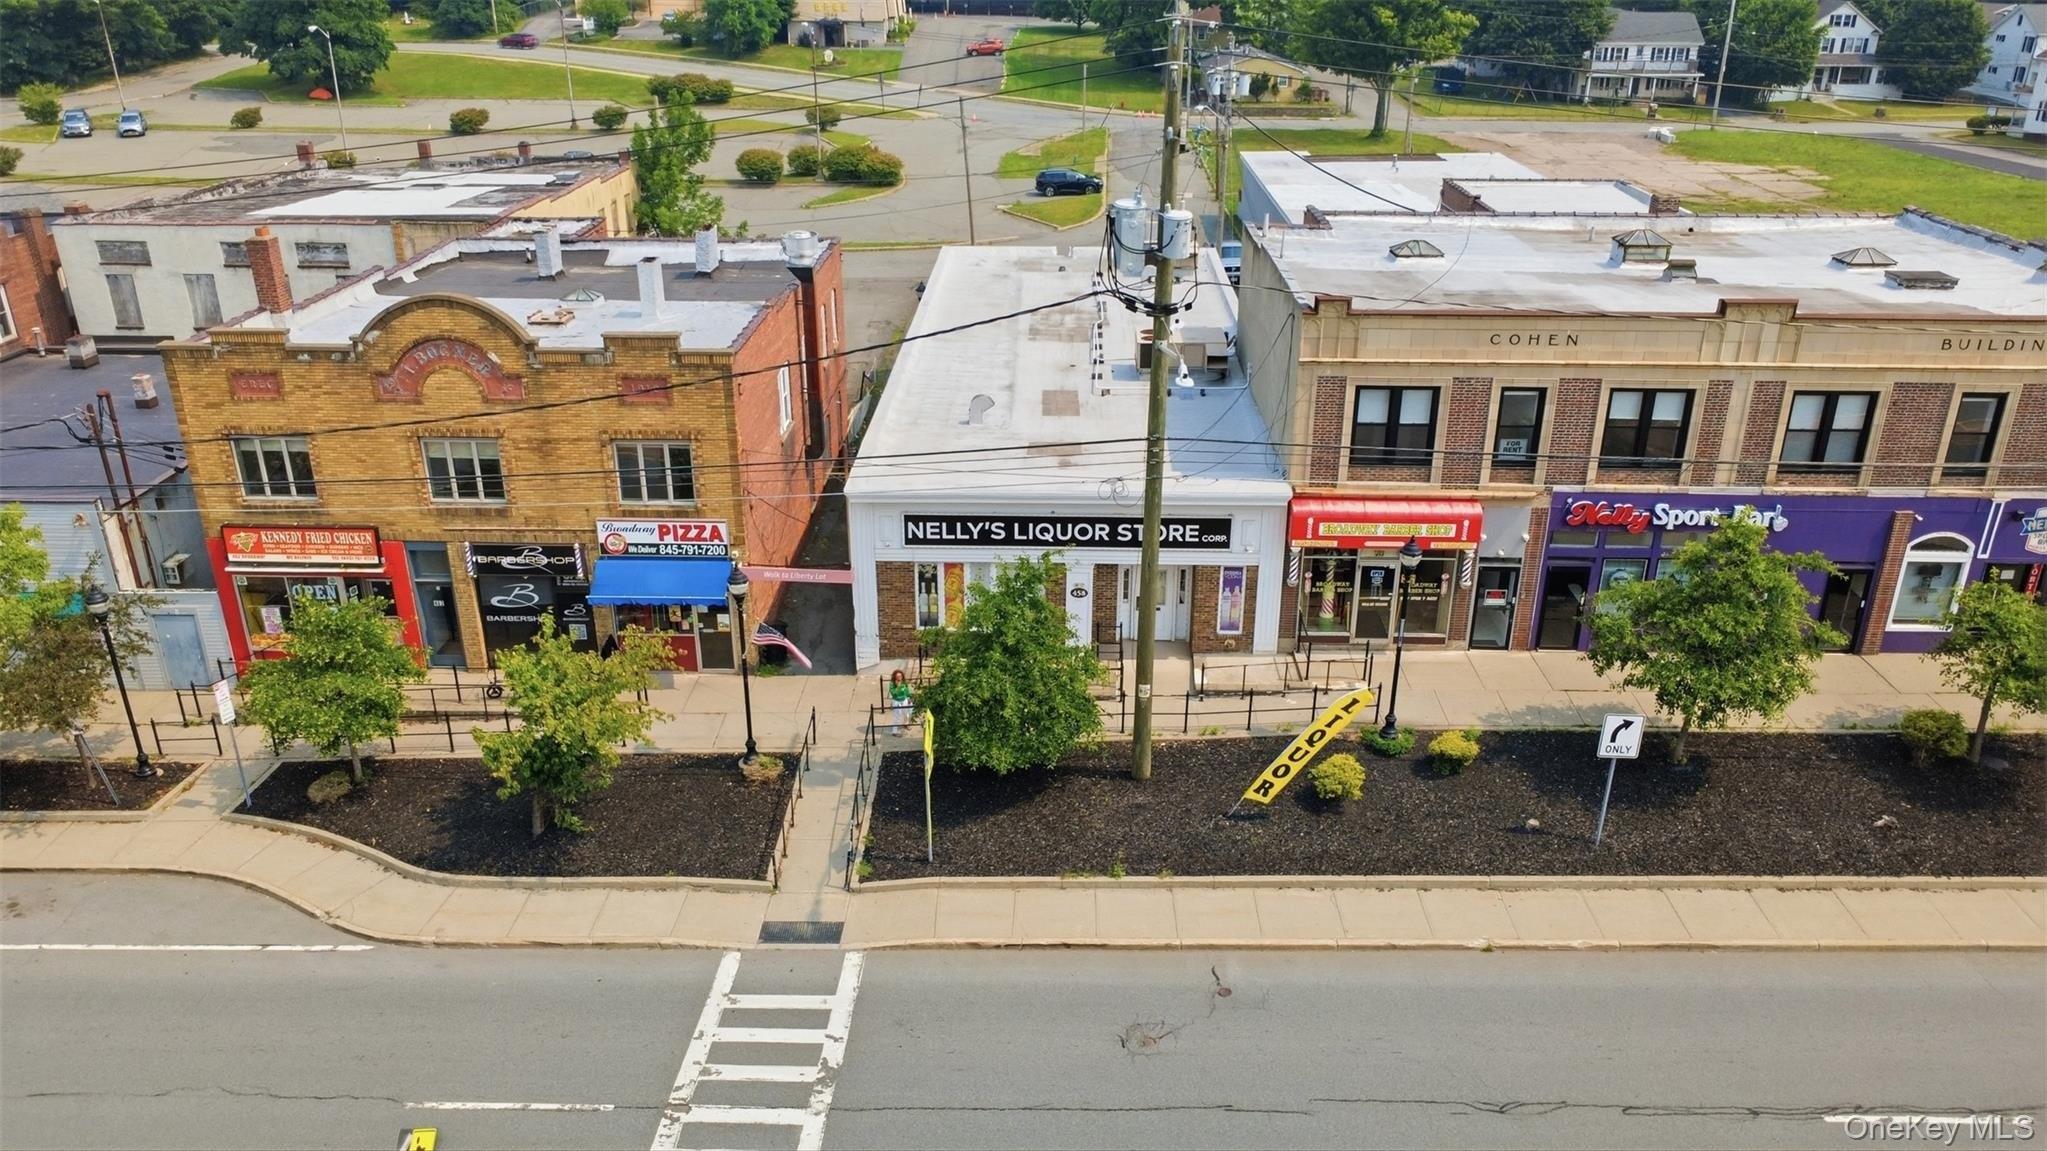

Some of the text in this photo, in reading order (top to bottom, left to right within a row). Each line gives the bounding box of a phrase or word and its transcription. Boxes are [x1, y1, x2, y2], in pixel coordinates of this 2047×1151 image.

[1489, 333, 2046, 351] COHEN BUILDIN
[1566, 500, 1651, 534] Nelly
[1653, 503, 1720, 530] Sport
[600, 522, 725, 542] Broadway PIZZA
[907, 521, 1006, 539] NELLY'S
[1013, 522, 1110, 542] LIQUOR
[1201, 534, 1228, 543] CORP.
[1322, 523, 1453, 536] BROADWAY BARBER SHOP
[260, 531, 373, 545] KENNEDY FRIED CHICKEN
[628, 544, 726, 556] We Deliver 845-791-7200
[292, 584, 337, 600] OPEN
[486, 614, 541, 622] BARBERSH
[1253, 698, 1360, 797] LIQUOR
[1605, 745, 1632, 754] ONLY
